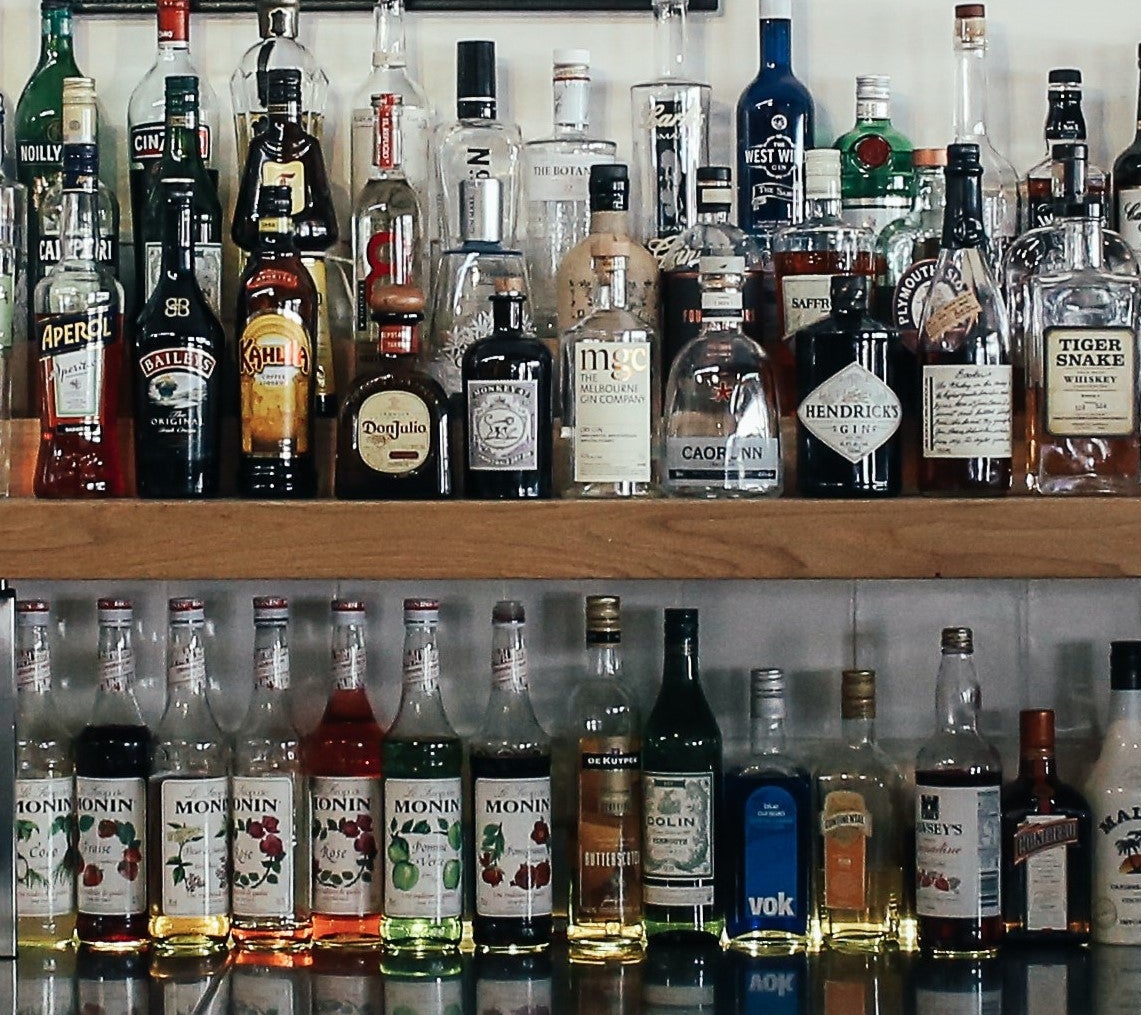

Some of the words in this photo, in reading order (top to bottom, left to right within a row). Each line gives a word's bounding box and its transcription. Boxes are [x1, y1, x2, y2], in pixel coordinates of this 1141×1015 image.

[20, 143, 62, 162] NOILLY
[745, 149, 776, 164] WEST
[1058, 338, 1122, 352] TIGER
[1056, 353, 1126, 367] SNAKE
[1063, 375, 1118, 384] WHISKEY
[395, 799, 461, 814] MONIN
[486, 798, 550, 814] MONIN
[748, 891, 797, 917] vok
